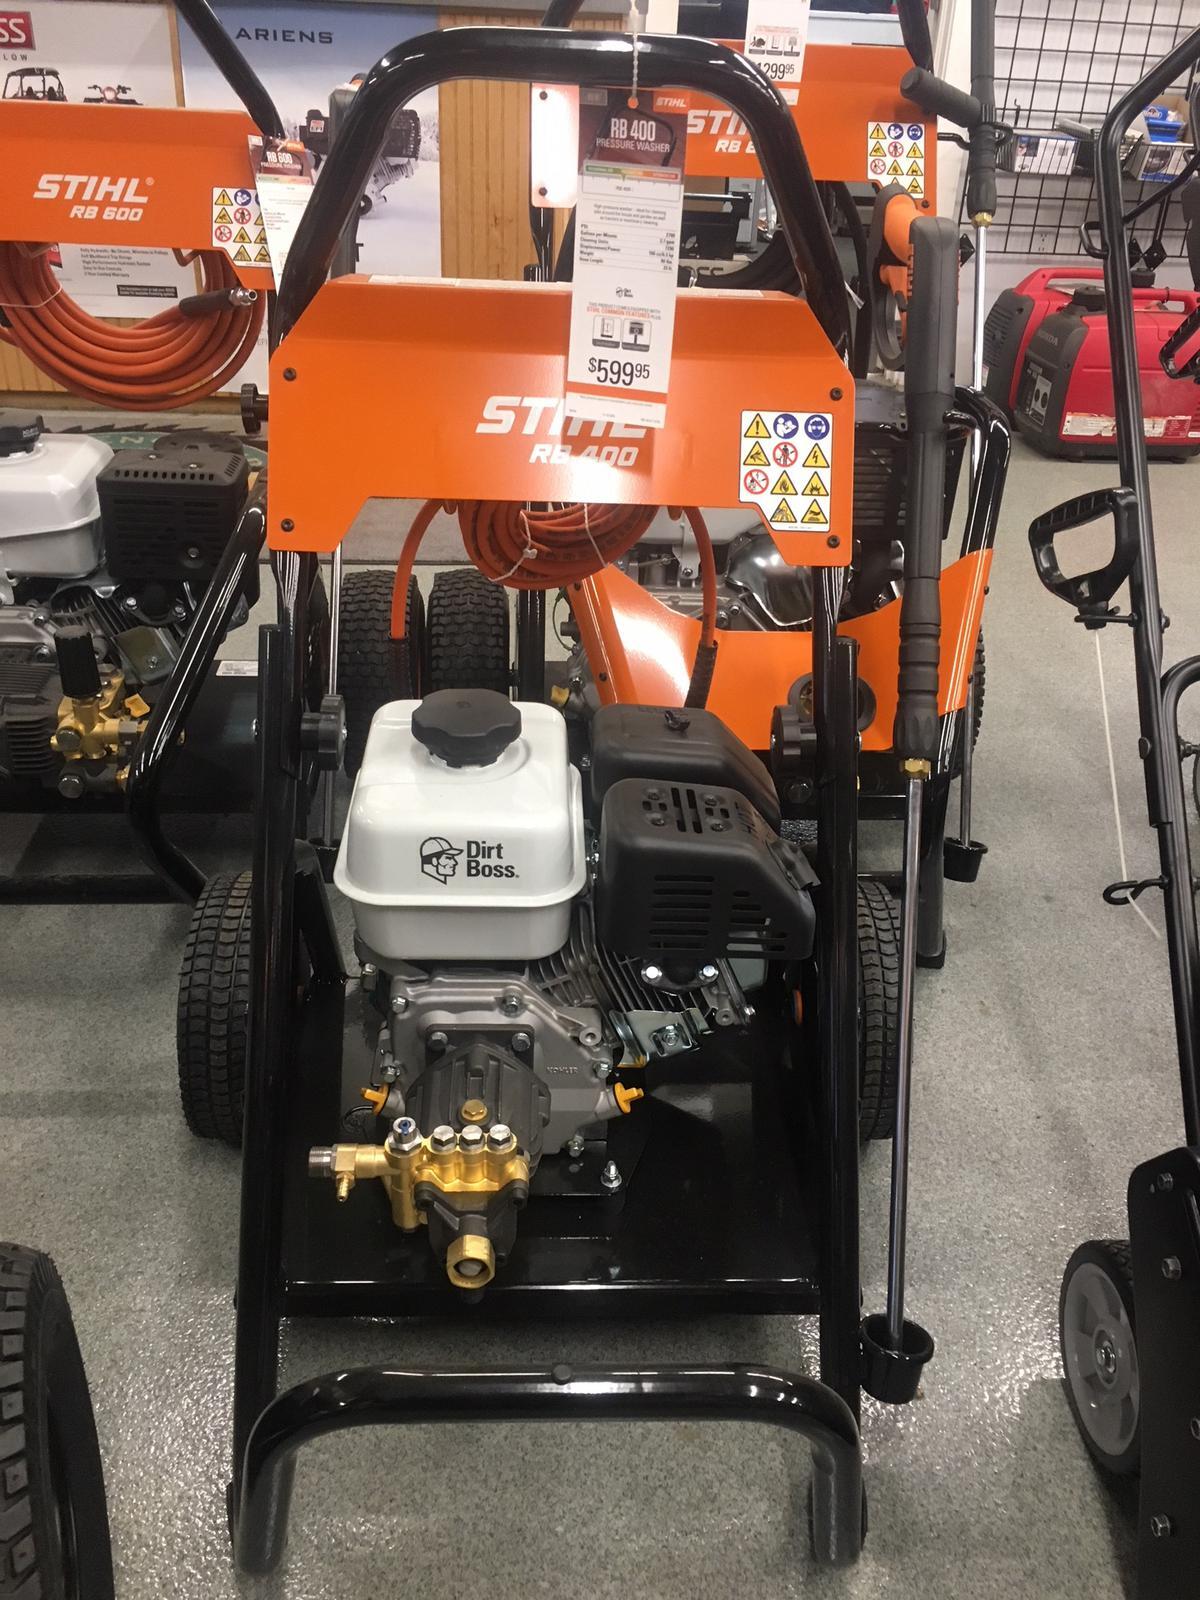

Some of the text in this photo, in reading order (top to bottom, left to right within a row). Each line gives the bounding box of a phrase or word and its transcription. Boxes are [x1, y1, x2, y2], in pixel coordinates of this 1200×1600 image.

[236, 27, 333, 44] ARIENS
[656, 97, 686, 107] STIHL
[611, 118, 656, 141] RB 400
[596, 137, 670, 152] PRESSURE WASHER
[714, 140, 741, 153] RB
[33, 174, 149, 203] STIHL
[69, 205, 143, 221] RB 600
[529, 444, 572, 464] RB
[467, 840, 504, 859] Dirt
